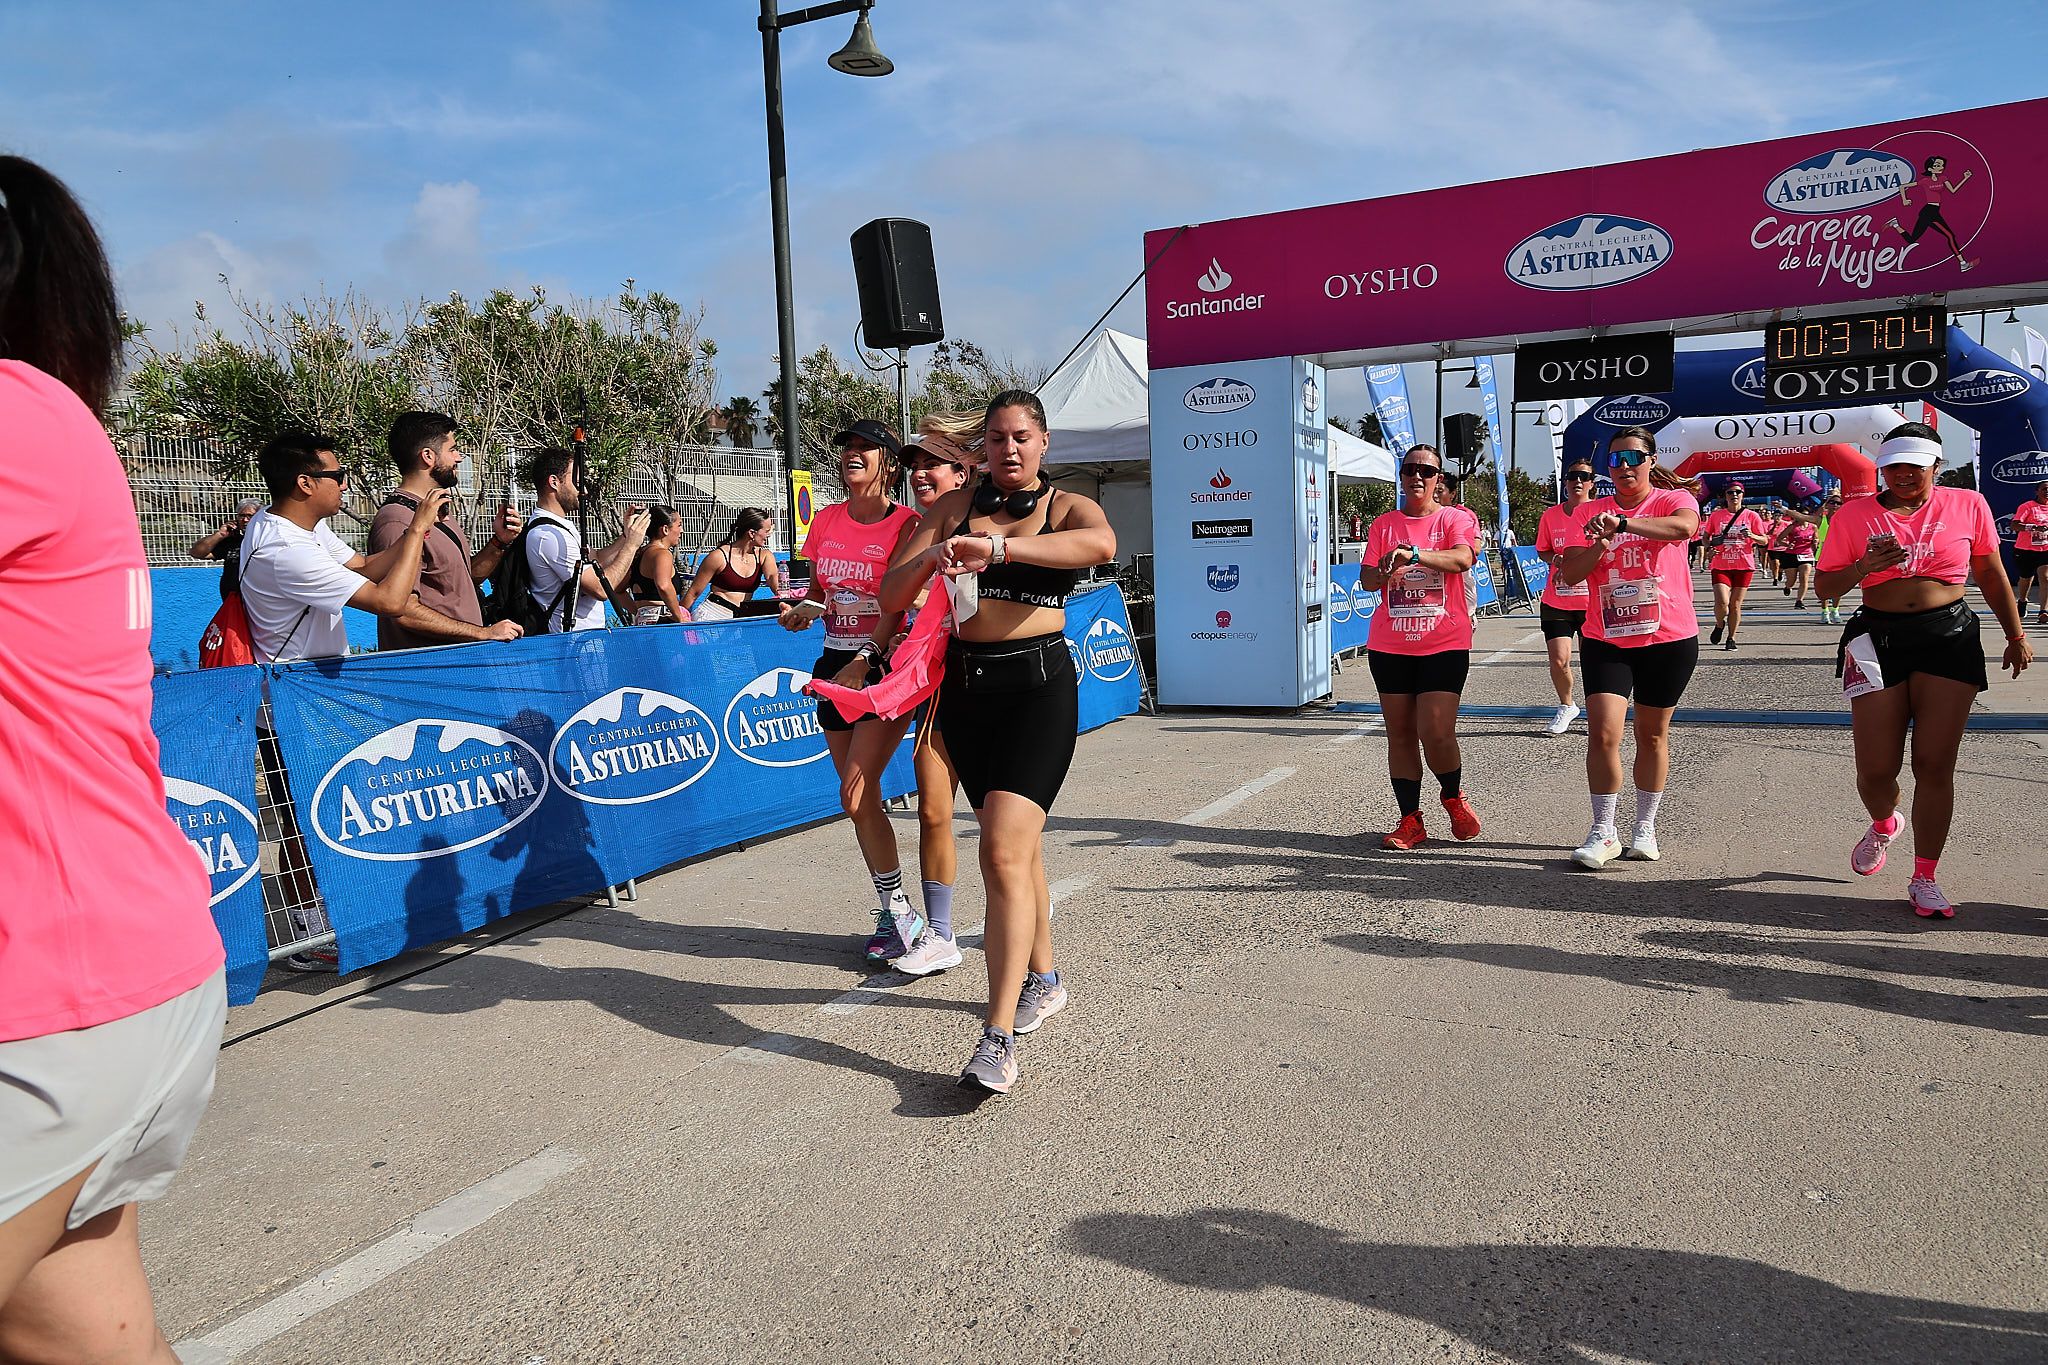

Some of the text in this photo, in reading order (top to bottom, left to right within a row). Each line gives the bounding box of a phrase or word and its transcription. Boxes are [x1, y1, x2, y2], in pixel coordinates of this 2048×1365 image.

[1797, 163, 1899, 183] CENTRAL LECHERA
[1775, 172, 1901, 204] ASTURIANA
[1542, 233, 1654, 253] CENTRAL LECHERA
[1750, 215, 1872, 249] Carrera
[1517, 243, 1660, 277] ASTURIANA
[1778, 232, 1919, 289] de la Mujer
[1324, 263, 1438, 299] OYSHO
[1166, 293, 1265, 319] Santander
[1777, 315, 1933, 360] 00:37:04
[1539, 354, 1649, 383] OYSHO
[1773, 360, 1939, 400] OYSHO
[1942, 381, 2025, 400] ASTURIANA
[1188, 392, 1251, 407] ASTURIANA
[1599, 408, 1664, 419] ASTURIANA
[1714, 412, 1836, 440] OYSHO
[1183, 429, 1258, 451] OYSHO
[1707, 445, 1813, 461] Sports Santander
[1190, 489, 1252, 503] Santander
[1196, 524, 1249, 536] Neutrogena
[822, 540, 845, 550] OYSHO
[1622, 547, 1641, 568] DE
[816, 557, 873, 581] CARRERA
[979, 588, 1011, 599] UMA
[1020, 592, 1059, 607] PUMA
[1405, 589, 1426, 598] 016
[835, 615, 858, 626] 016
[1616, 605, 1639, 617] 016
[1392, 617, 1435, 631] MUJER
[1190, 632, 1258, 642] octopus energy
[1088, 644, 1133, 669] ASTURIANA
[752, 701, 795, 716] CENTRAL
[588, 716, 699, 746] CENTRAL LECHERA
[738, 711, 824, 750] ASTURIA
[367, 750, 521, 789] CENTRAL LECHERA
[568, 731, 711, 787] ASTURIANA
[338, 767, 538, 842] ASTURIANA
